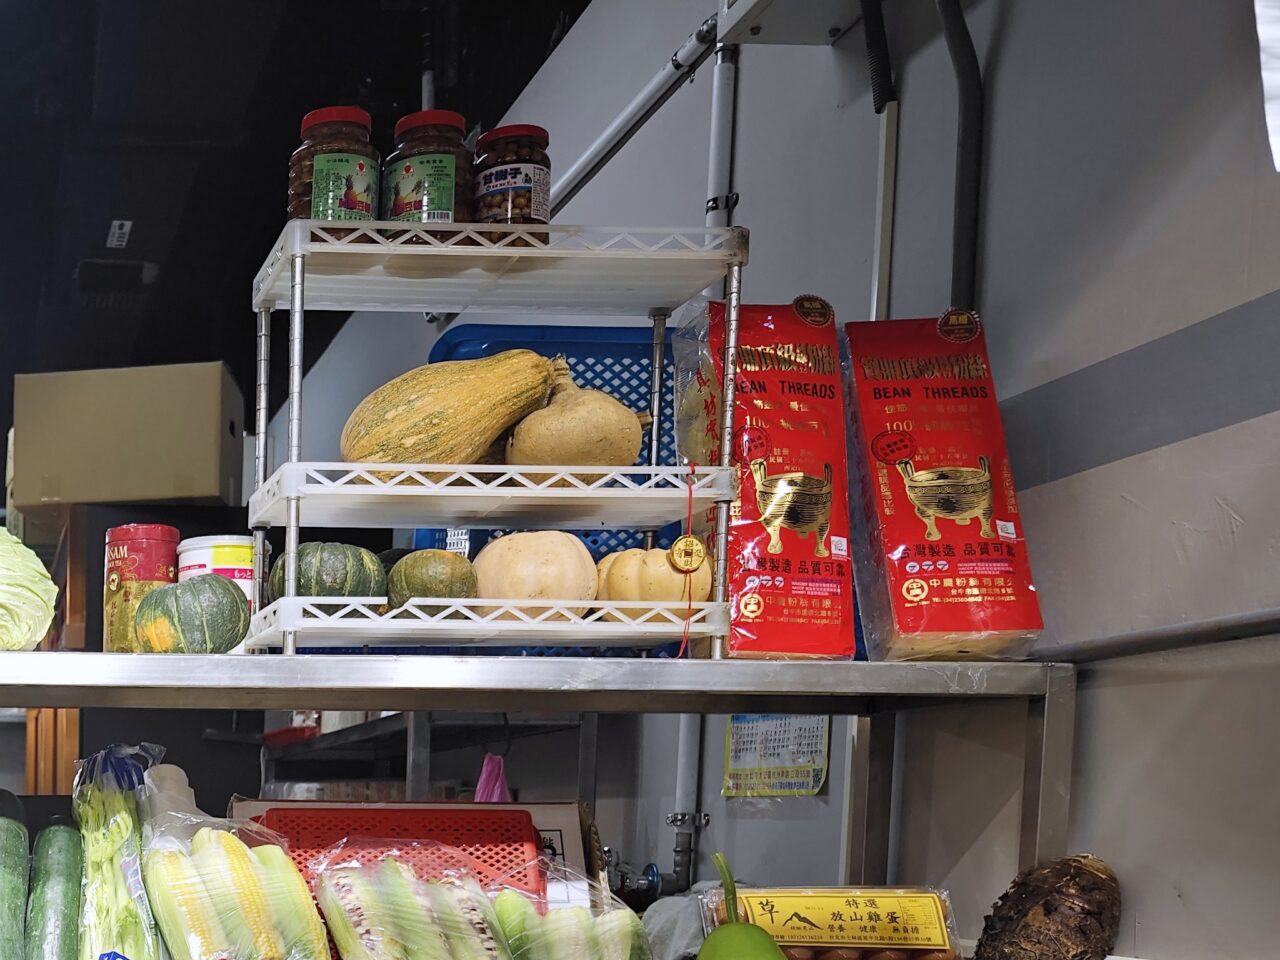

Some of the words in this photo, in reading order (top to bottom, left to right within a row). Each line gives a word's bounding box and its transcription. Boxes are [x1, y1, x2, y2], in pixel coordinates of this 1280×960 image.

[779, 380, 835, 399] THREADS
[873, 387, 912, 400] BEAN
[922, 386, 989, 399] THREADS
[845, 898, 880, 909] 特選
[758, 899, 779, 924] 草
[830, 910, 901, 924] 放山雞蛋
